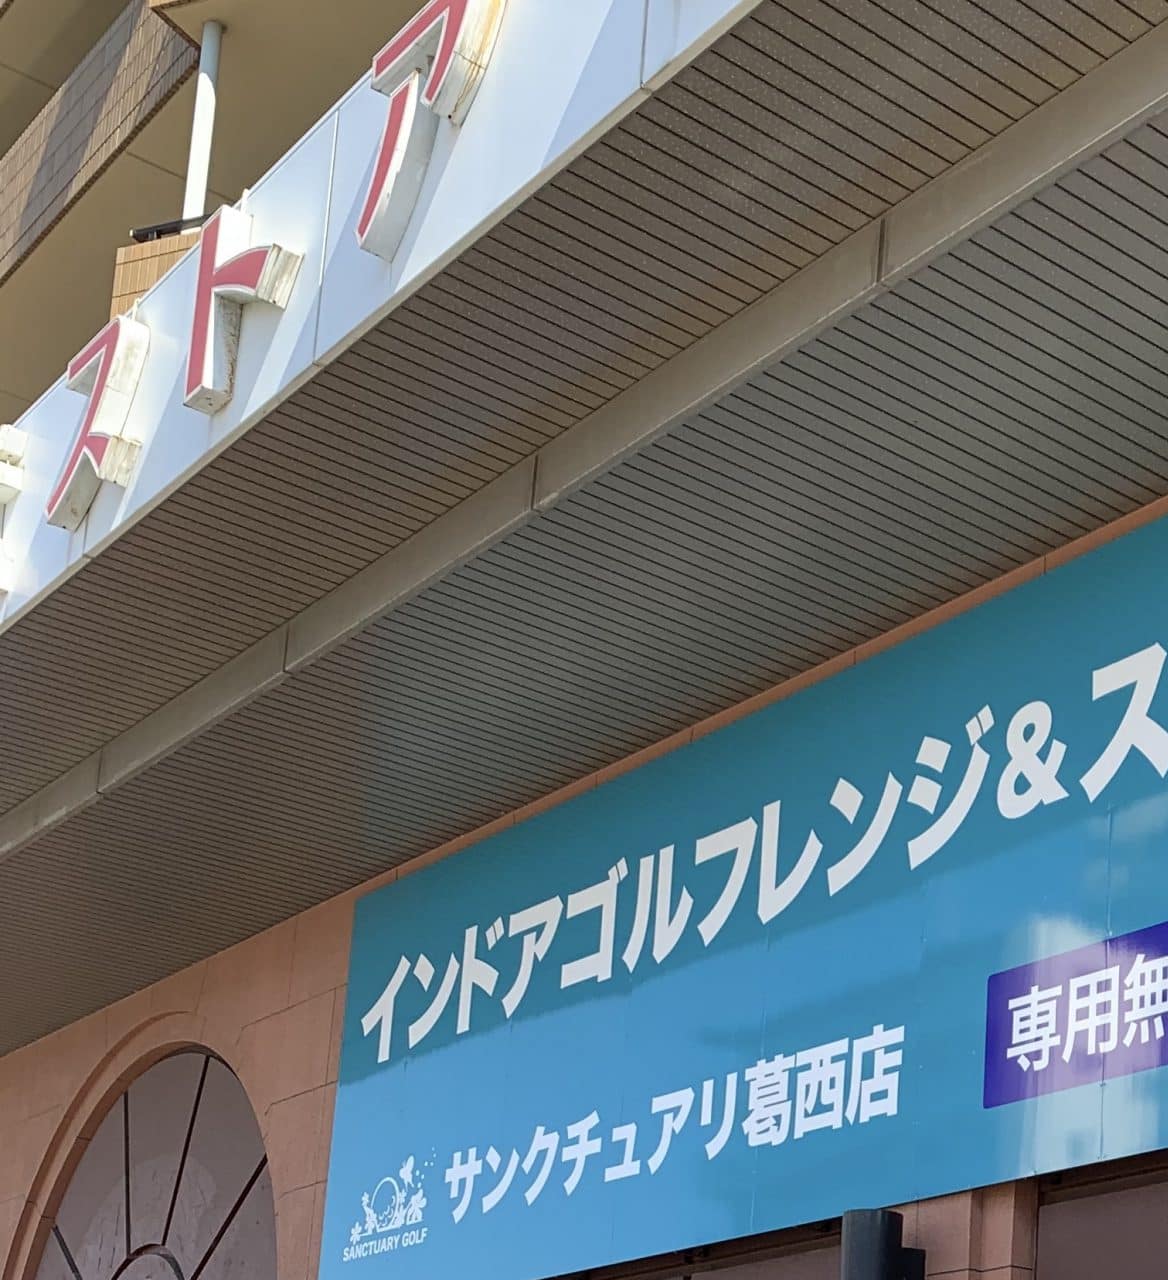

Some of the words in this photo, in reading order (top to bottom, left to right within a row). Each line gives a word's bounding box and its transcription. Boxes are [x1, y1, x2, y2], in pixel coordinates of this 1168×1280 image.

[444, 1023, 905, 1225] サンクチュアリ葛西店
[343, 1234, 400, 1262] SANCTUARY
[401, 1227, 428, 1248] GOLF
